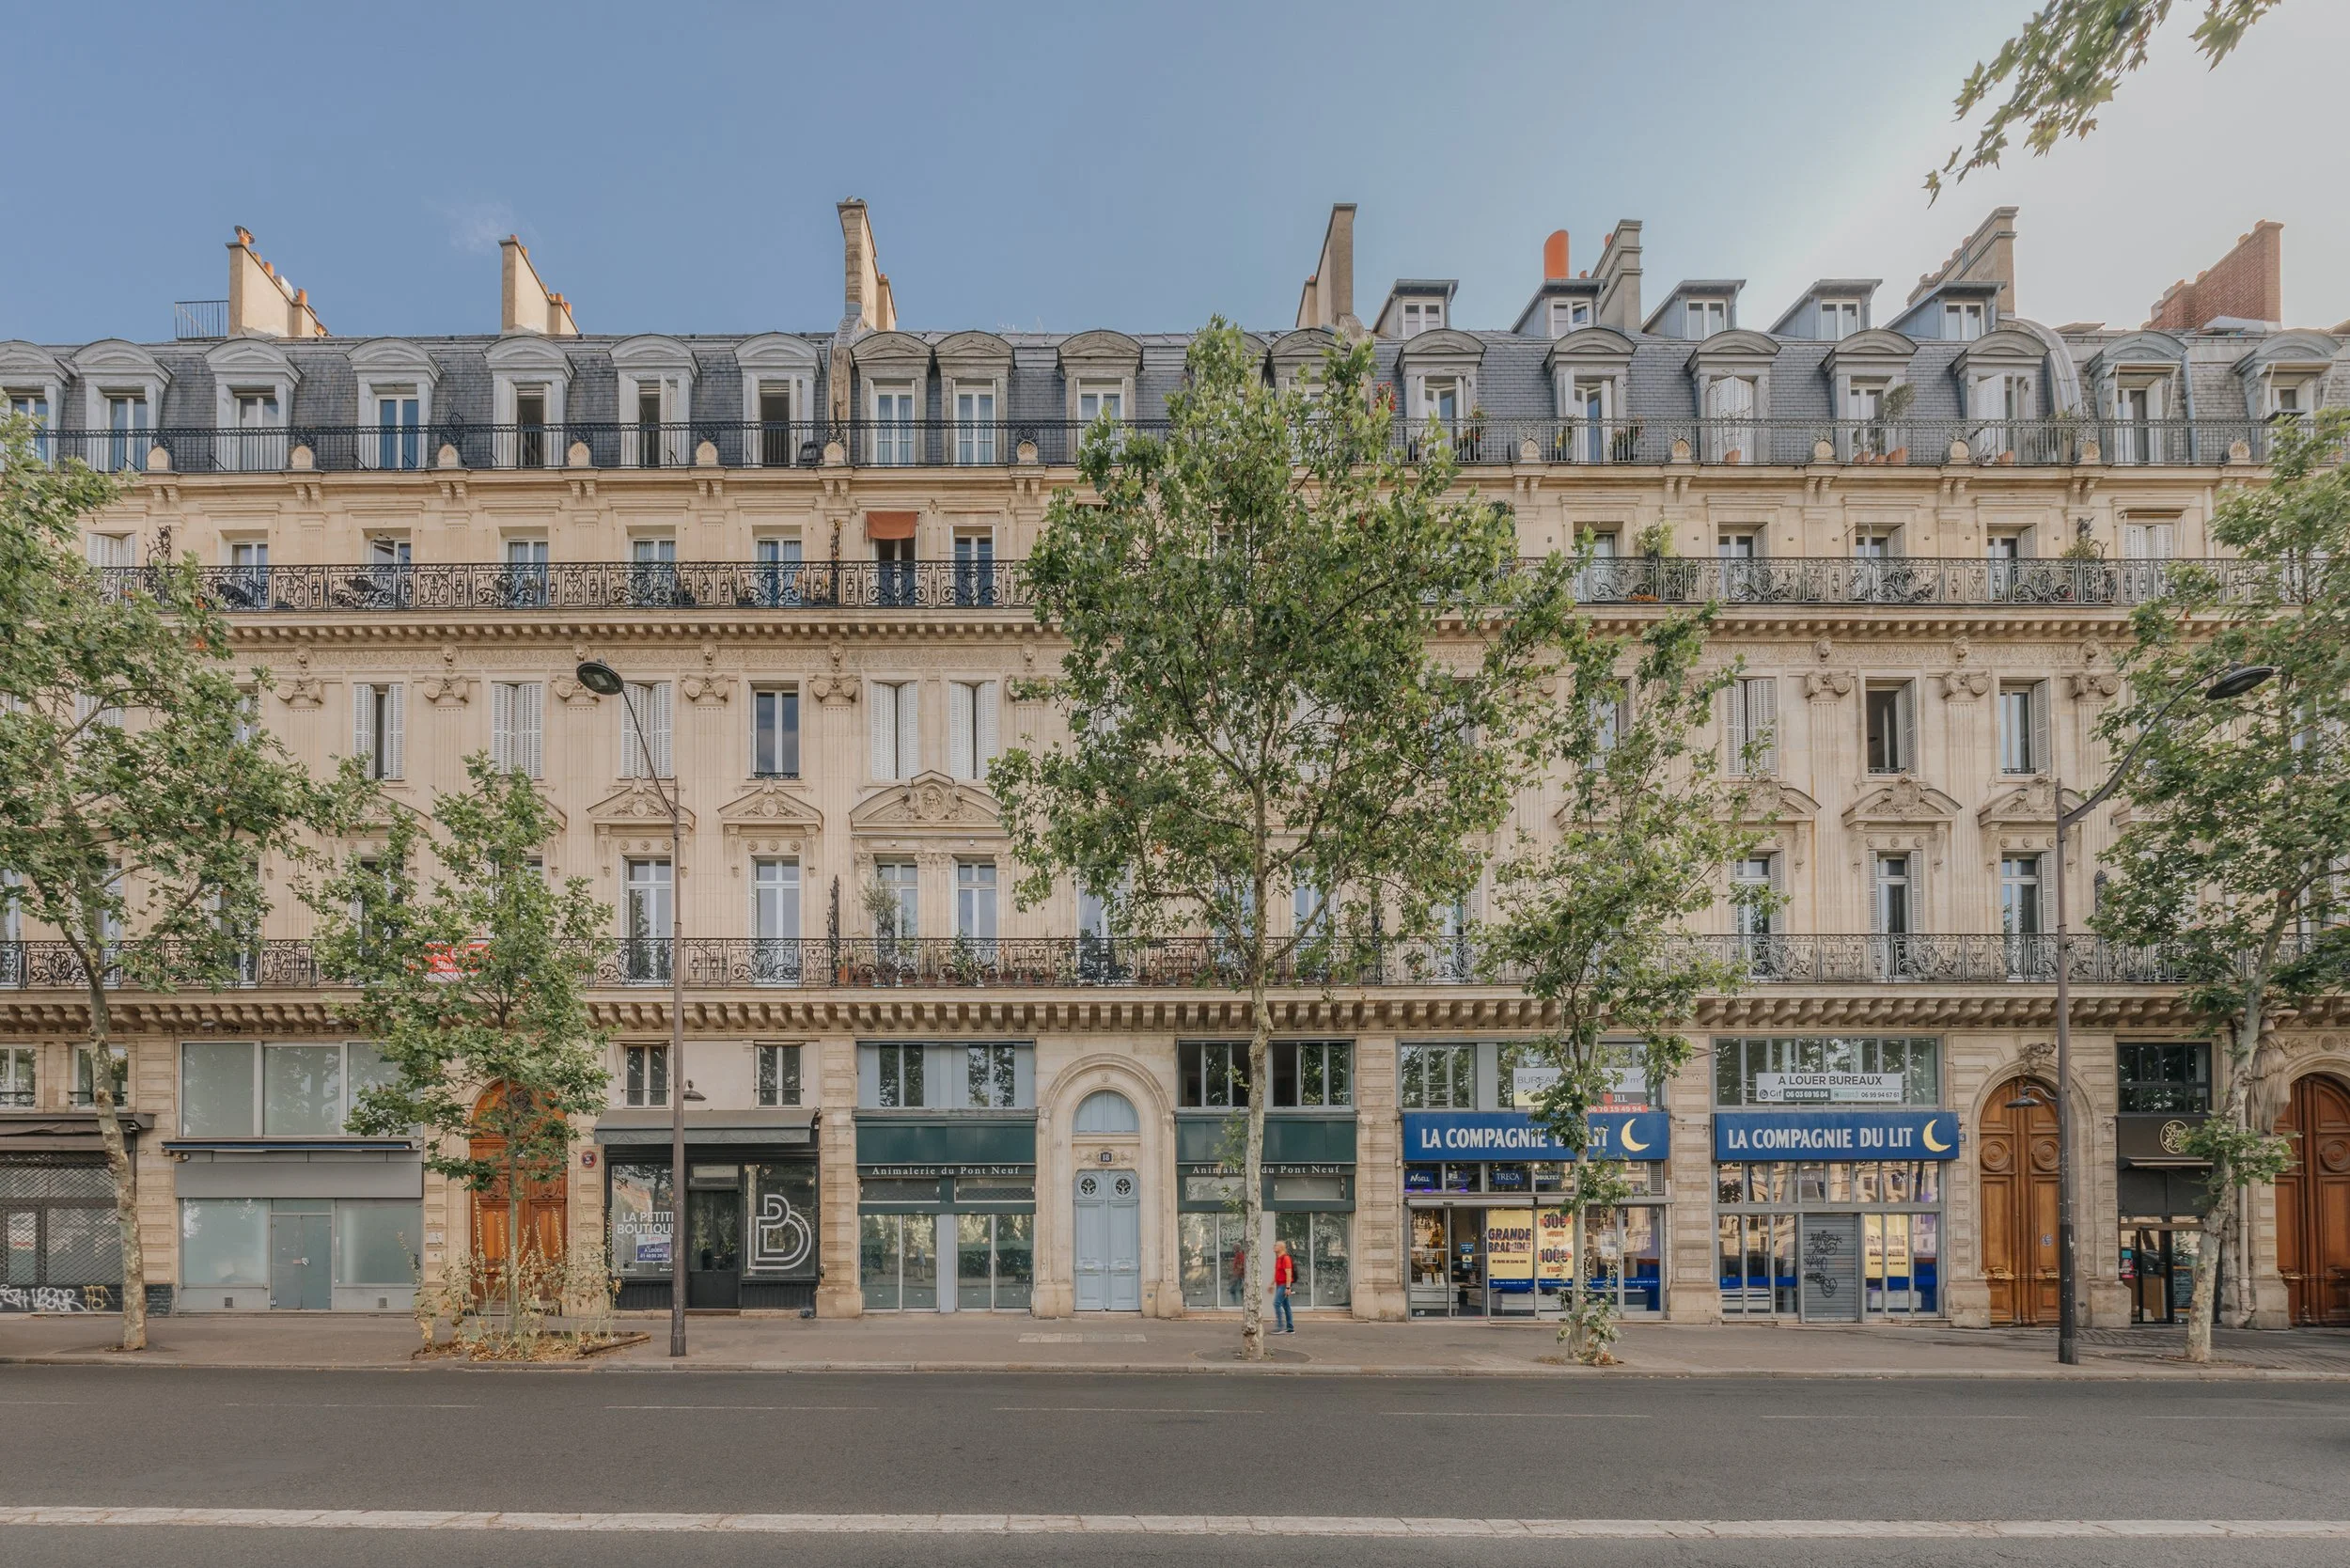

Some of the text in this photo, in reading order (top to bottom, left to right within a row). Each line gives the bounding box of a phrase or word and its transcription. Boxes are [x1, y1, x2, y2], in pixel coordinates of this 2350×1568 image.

[1517, 1075, 1559, 1084] BUREAU
[1778, 1075, 1883, 1085] A LOUER BUREAUX
[1614, 1094, 1627, 1103] JLL
[1421, 1128, 1441, 1149] LA
[1446, 1128, 1547, 1149] COMPAGNIE
[1728, 1127, 1914, 1149] LA COMPAGNIE DU LIT
[872, 1167, 936, 1175] Animalerie
[991, 1166, 1020, 1174] Neuf
[1192, 1166, 1340, 1174] Animale du Pont Neuf
[1496, 1172, 1520, 1181] TRECA
[623, 1212, 636, 1222] LA
[1543, 1214, 1567, 1229] 30€
[1488, 1228, 1531, 1241] GRANDE
[1540, 1248, 1568, 1263] 100€
